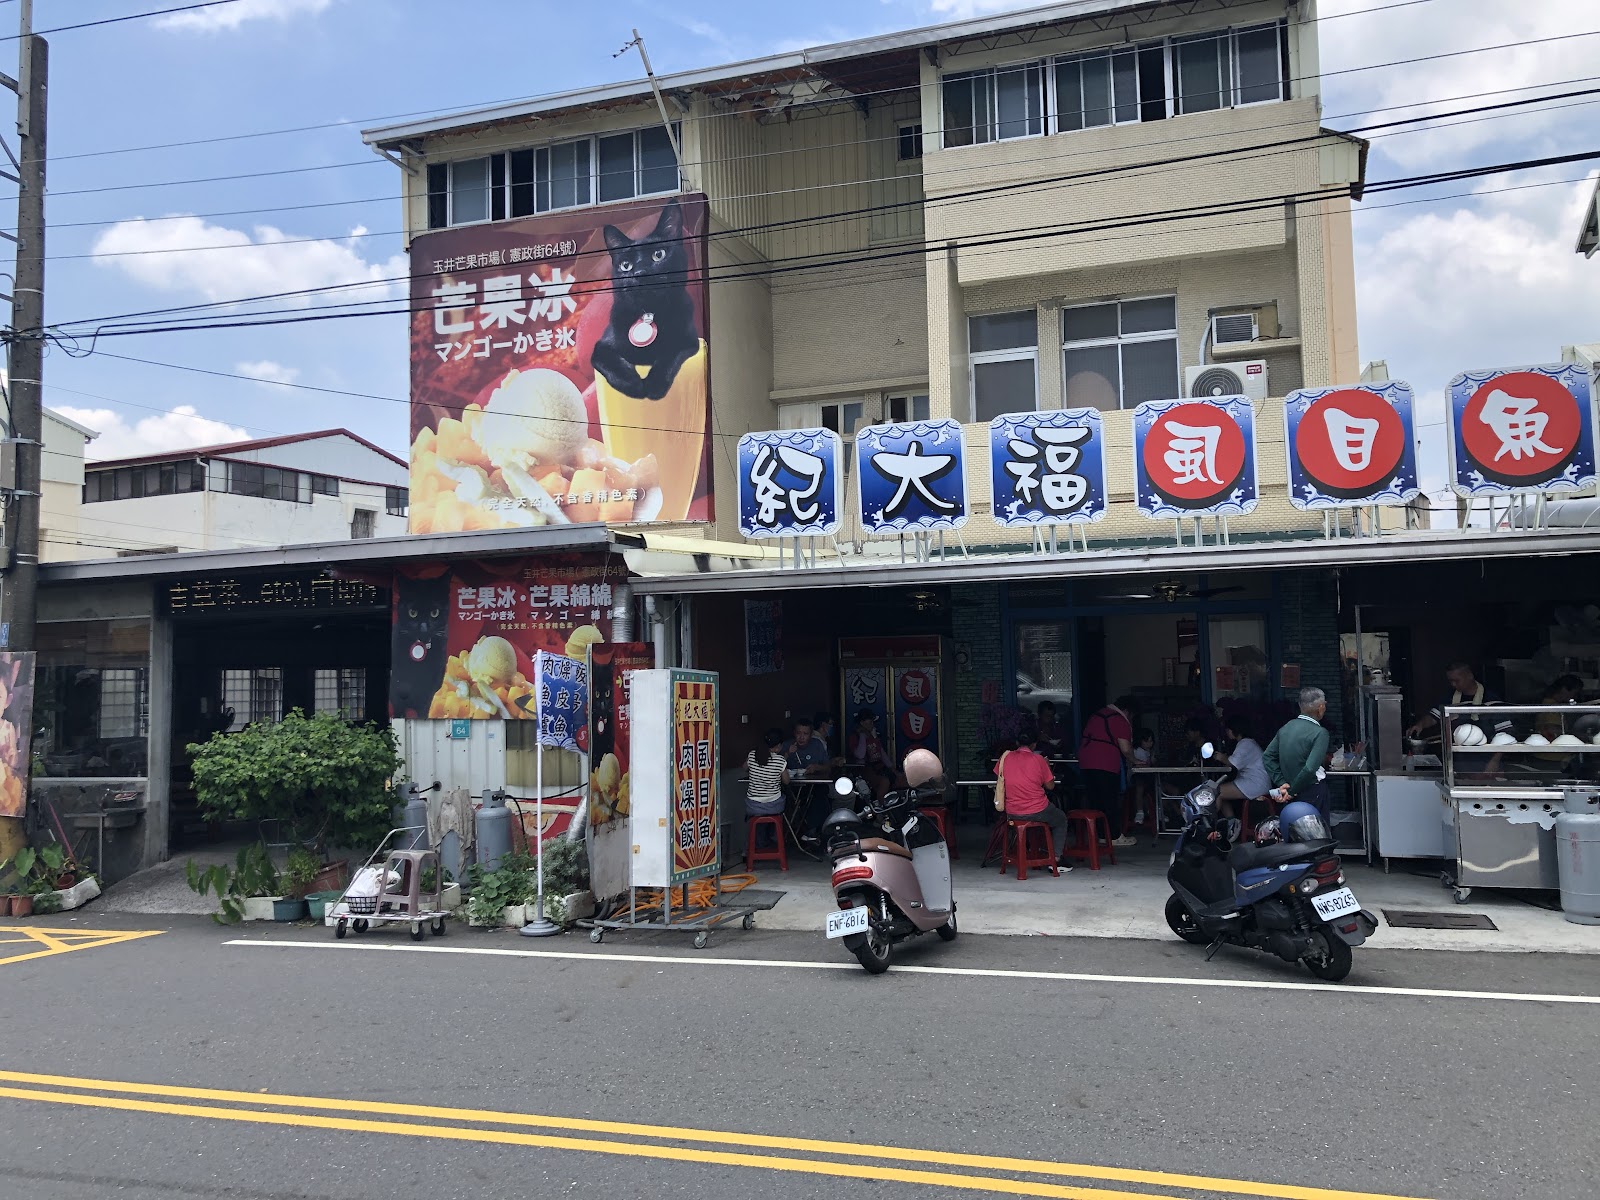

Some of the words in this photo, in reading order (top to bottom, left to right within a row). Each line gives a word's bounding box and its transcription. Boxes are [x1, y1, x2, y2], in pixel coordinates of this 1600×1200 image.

[432, 268, 577, 335] 芒果冰
[434, 326, 576, 362] マンゴーかき氷
[456, 726, 466, 735] 64
[679, 740, 695, 850] 肉燥飯
[697, 740, 712, 849] 虱目魚
